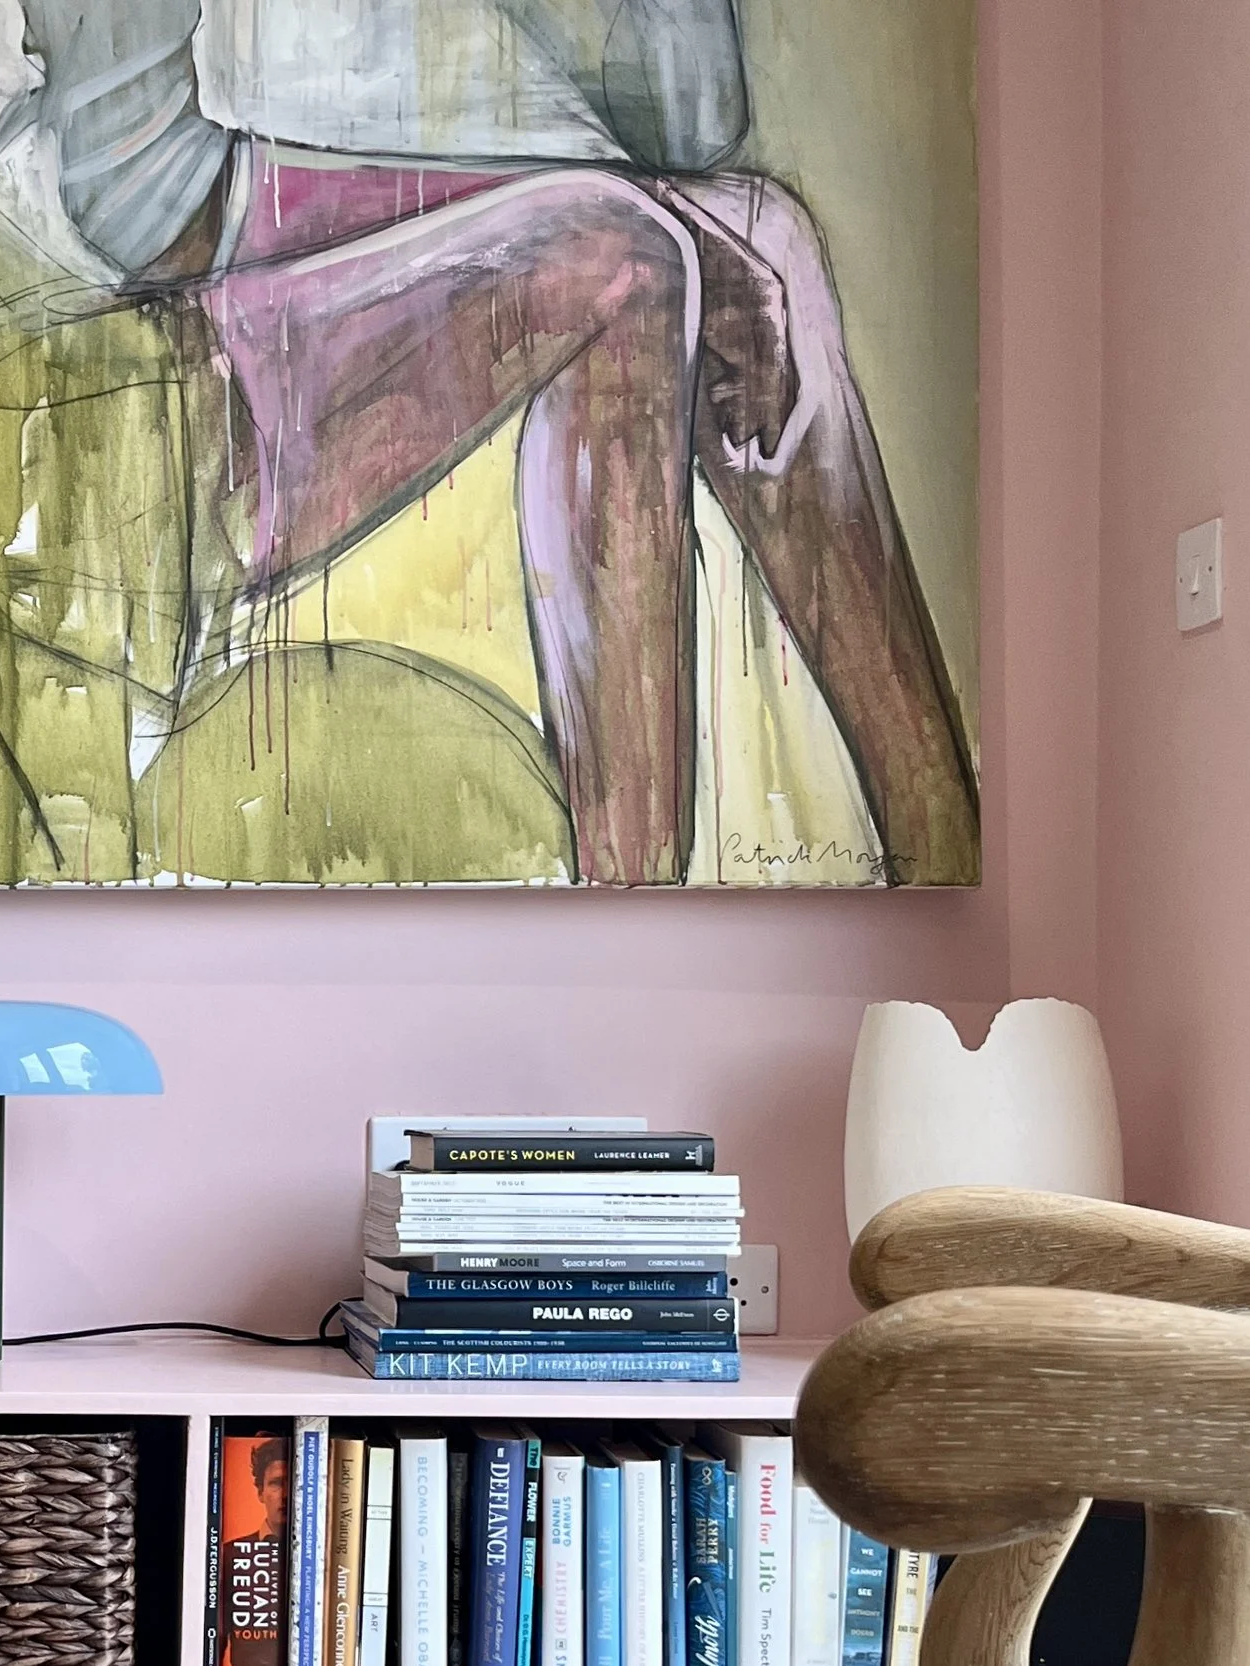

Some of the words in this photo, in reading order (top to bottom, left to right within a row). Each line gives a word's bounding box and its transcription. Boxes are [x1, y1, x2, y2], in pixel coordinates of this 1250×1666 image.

[720, 832, 810, 865] Patrick
[449, 1150, 518, 1161] CAPOTE'S
[521, 1150, 576, 1161] WOMEN
[594, 1152, 636, 1160] LAURENCE
[638, 1152, 670, 1160] LEAMER
[461, 1257, 498, 1268] HENRY
[499, 1258, 540, 1267] MOORE
[562, 1258, 588, 1268] Space
[588, 1258, 604, 1267] and
[605, 1258, 627, 1267] Form
[426, 1279, 456, 1290] THE
[461, 1279, 533, 1291] GLASGOW
[537, 1280, 574, 1291] BOYS
[591, 1280, 624, 1293] Roger
[628, 1280, 676, 1291] Billcliffe
[532, 1307, 584, 1320] PAULA
[588, 1307, 633, 1320] REGO
[389, 1353, 435, 1376] KIT
[447, 1353, 528, 1376] KEMP
[537, 1360, 572, 1370] EVERY
[574, 1360, 607, 1370] ROOM
[611, 1360, 644, 1370] TELLS
[655, 1360, 691, 1370] STORY
[307, 1454, 315, 1485] OUDOLF
[529, 1446, 538, 1467] The
[340, 1459, 354, 1491] Lady
[340, 1493, 352, 1504] in
[417, 1456, 428, 1537] BECOMING
[526, 1482, 538, 1522] FLOWER
[637, 1472, 645, 1525] CHARLOTTE
[760, 1464, 777, 1515] Food
[306, 1494, 314, 1517] NOEL
[487, 1462, 510, 1566] DEFIANCE
[337, 1508, 353, 1555] Waiting
[552, 1498, 561, 1545] BONNIE
[563, 1496, 572, 1547] GARMUS
[760, 1523, 772, 1545] for
[270, 1542, 279, 1563] THE
[305, 1518, 313, 1560] KINGSBURY
[598, 1528, 611, 1554] Life
[637, 1526, 645, 1563] MULLINS
[696, 1517, 707, 1564] SARAH
[707, 1519, 718, 1564] PERRY
[861, 1548, 874, 1556] WE
[523, 1540, 535, 1579] EXPERT
[598, 1560, 611, 1570] A
[759, 1551, 777, 1593] Life
[850, 1568, 883, 1577] CANNOT
[232, 1542, 252, 1627] FREUD
[253, 1542, 270, 1627] LUCIAN
[270, 1571, 278, 1604] LIVES
[337, 1564, 351, 1599] Anne
[858, 1588, 873, 1597] SEE
[417, 1560, 428, 1633] MICHELLE
[555, 1561, 567, 1634] CHEMISTRY
[270, 1611, 278, 1626] OF
[370, 1613, 378, 1632] ART
[495, 1609, 504, 1622] and
[597, 1606, 612, 1640] Pour
[761, 1607, 772, 1630] Tim
[234, 1630, 278, 1640] YOUTH
